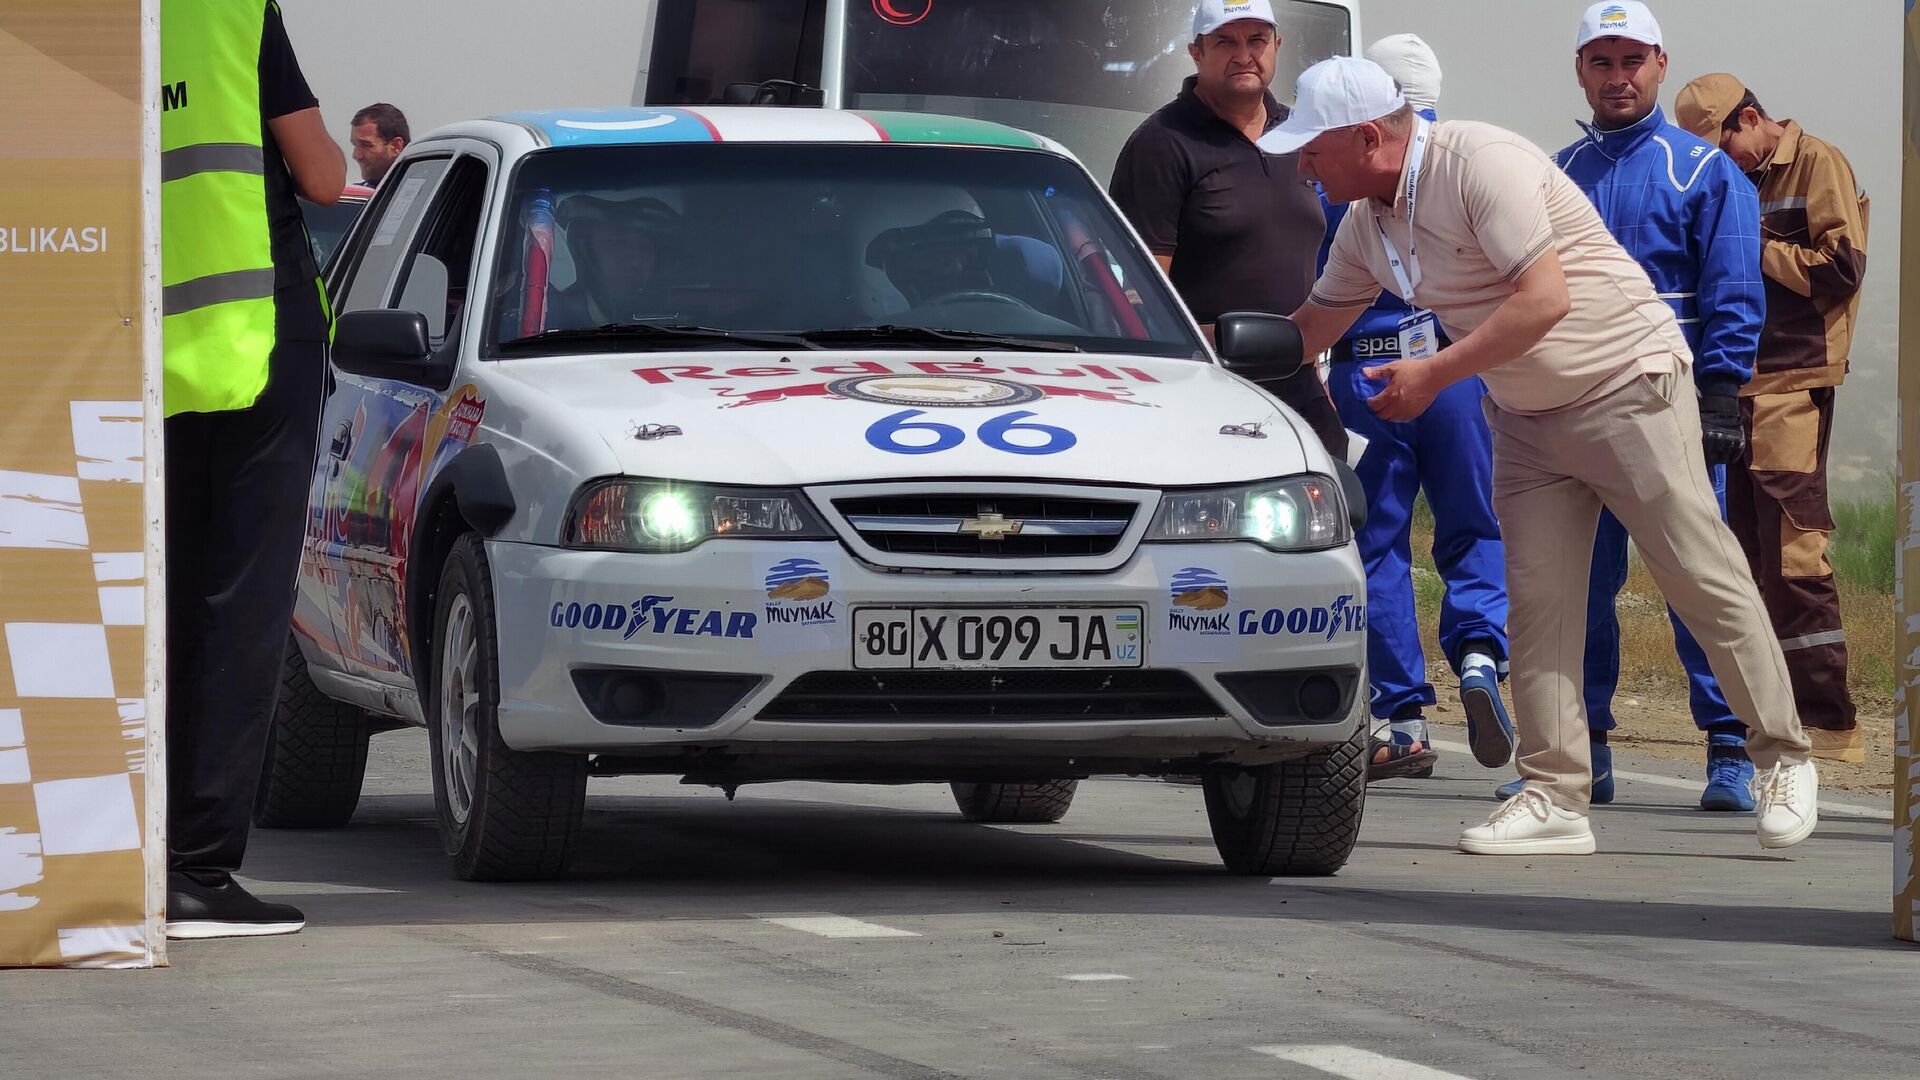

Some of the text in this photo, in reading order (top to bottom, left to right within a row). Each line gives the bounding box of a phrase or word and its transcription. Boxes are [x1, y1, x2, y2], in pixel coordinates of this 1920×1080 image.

[162, 80, 187, 112] M
[631, 361, 1163, 384] Red Bull
[865, 409, 1077, 456] 66
[765, 600, 835, 624] MUYNAK
[1169, 612, 1230, 631] MUYNAK
[1116, 644, 1137, 660] UZ
